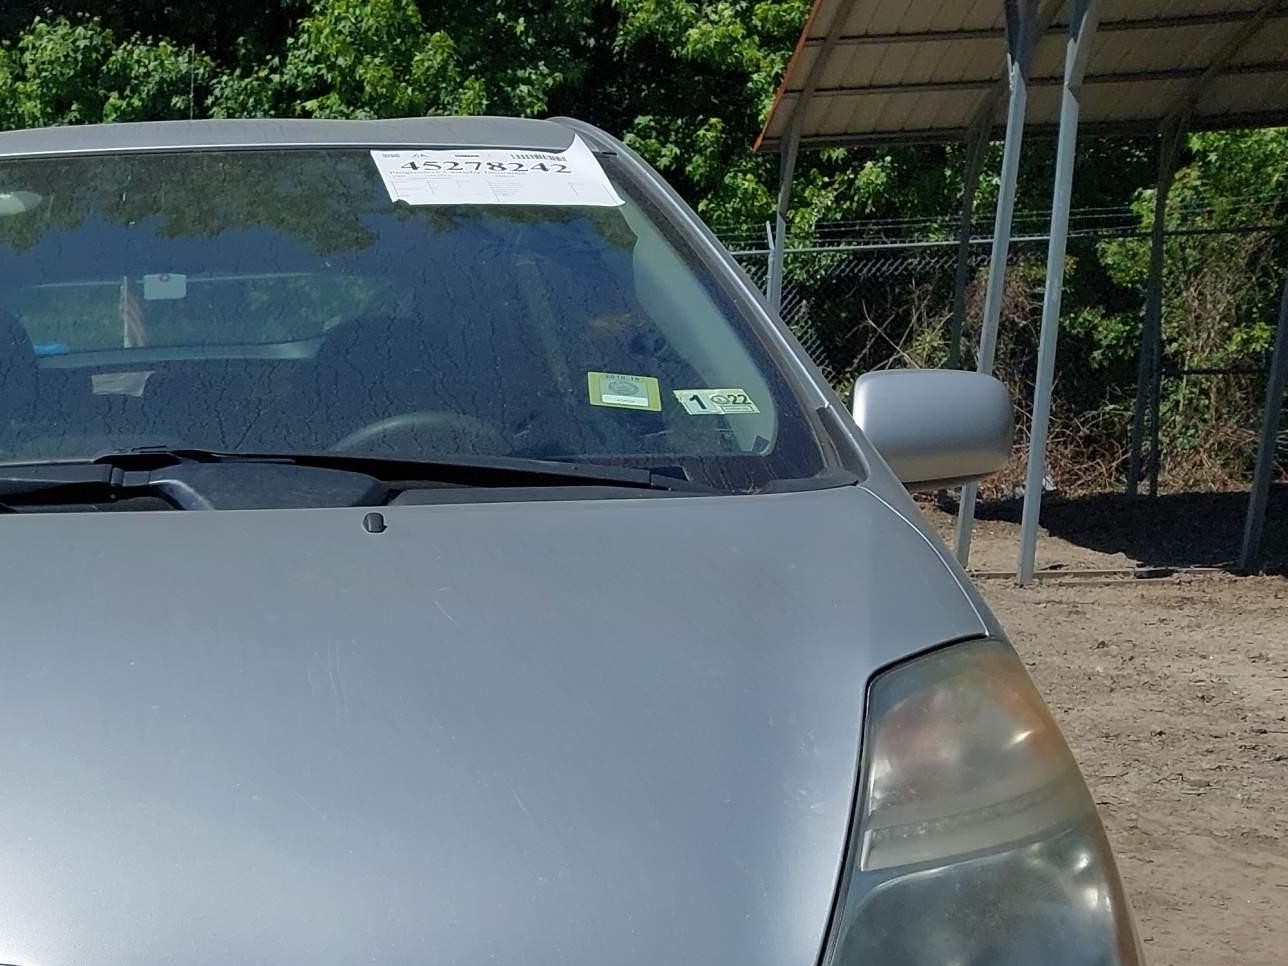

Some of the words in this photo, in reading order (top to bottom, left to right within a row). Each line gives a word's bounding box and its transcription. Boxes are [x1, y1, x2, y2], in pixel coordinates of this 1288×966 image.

[400, 161, 572, 174] 45278242
[689, 394, 707, 409] 1
[727, 394, 752, 405] 22
